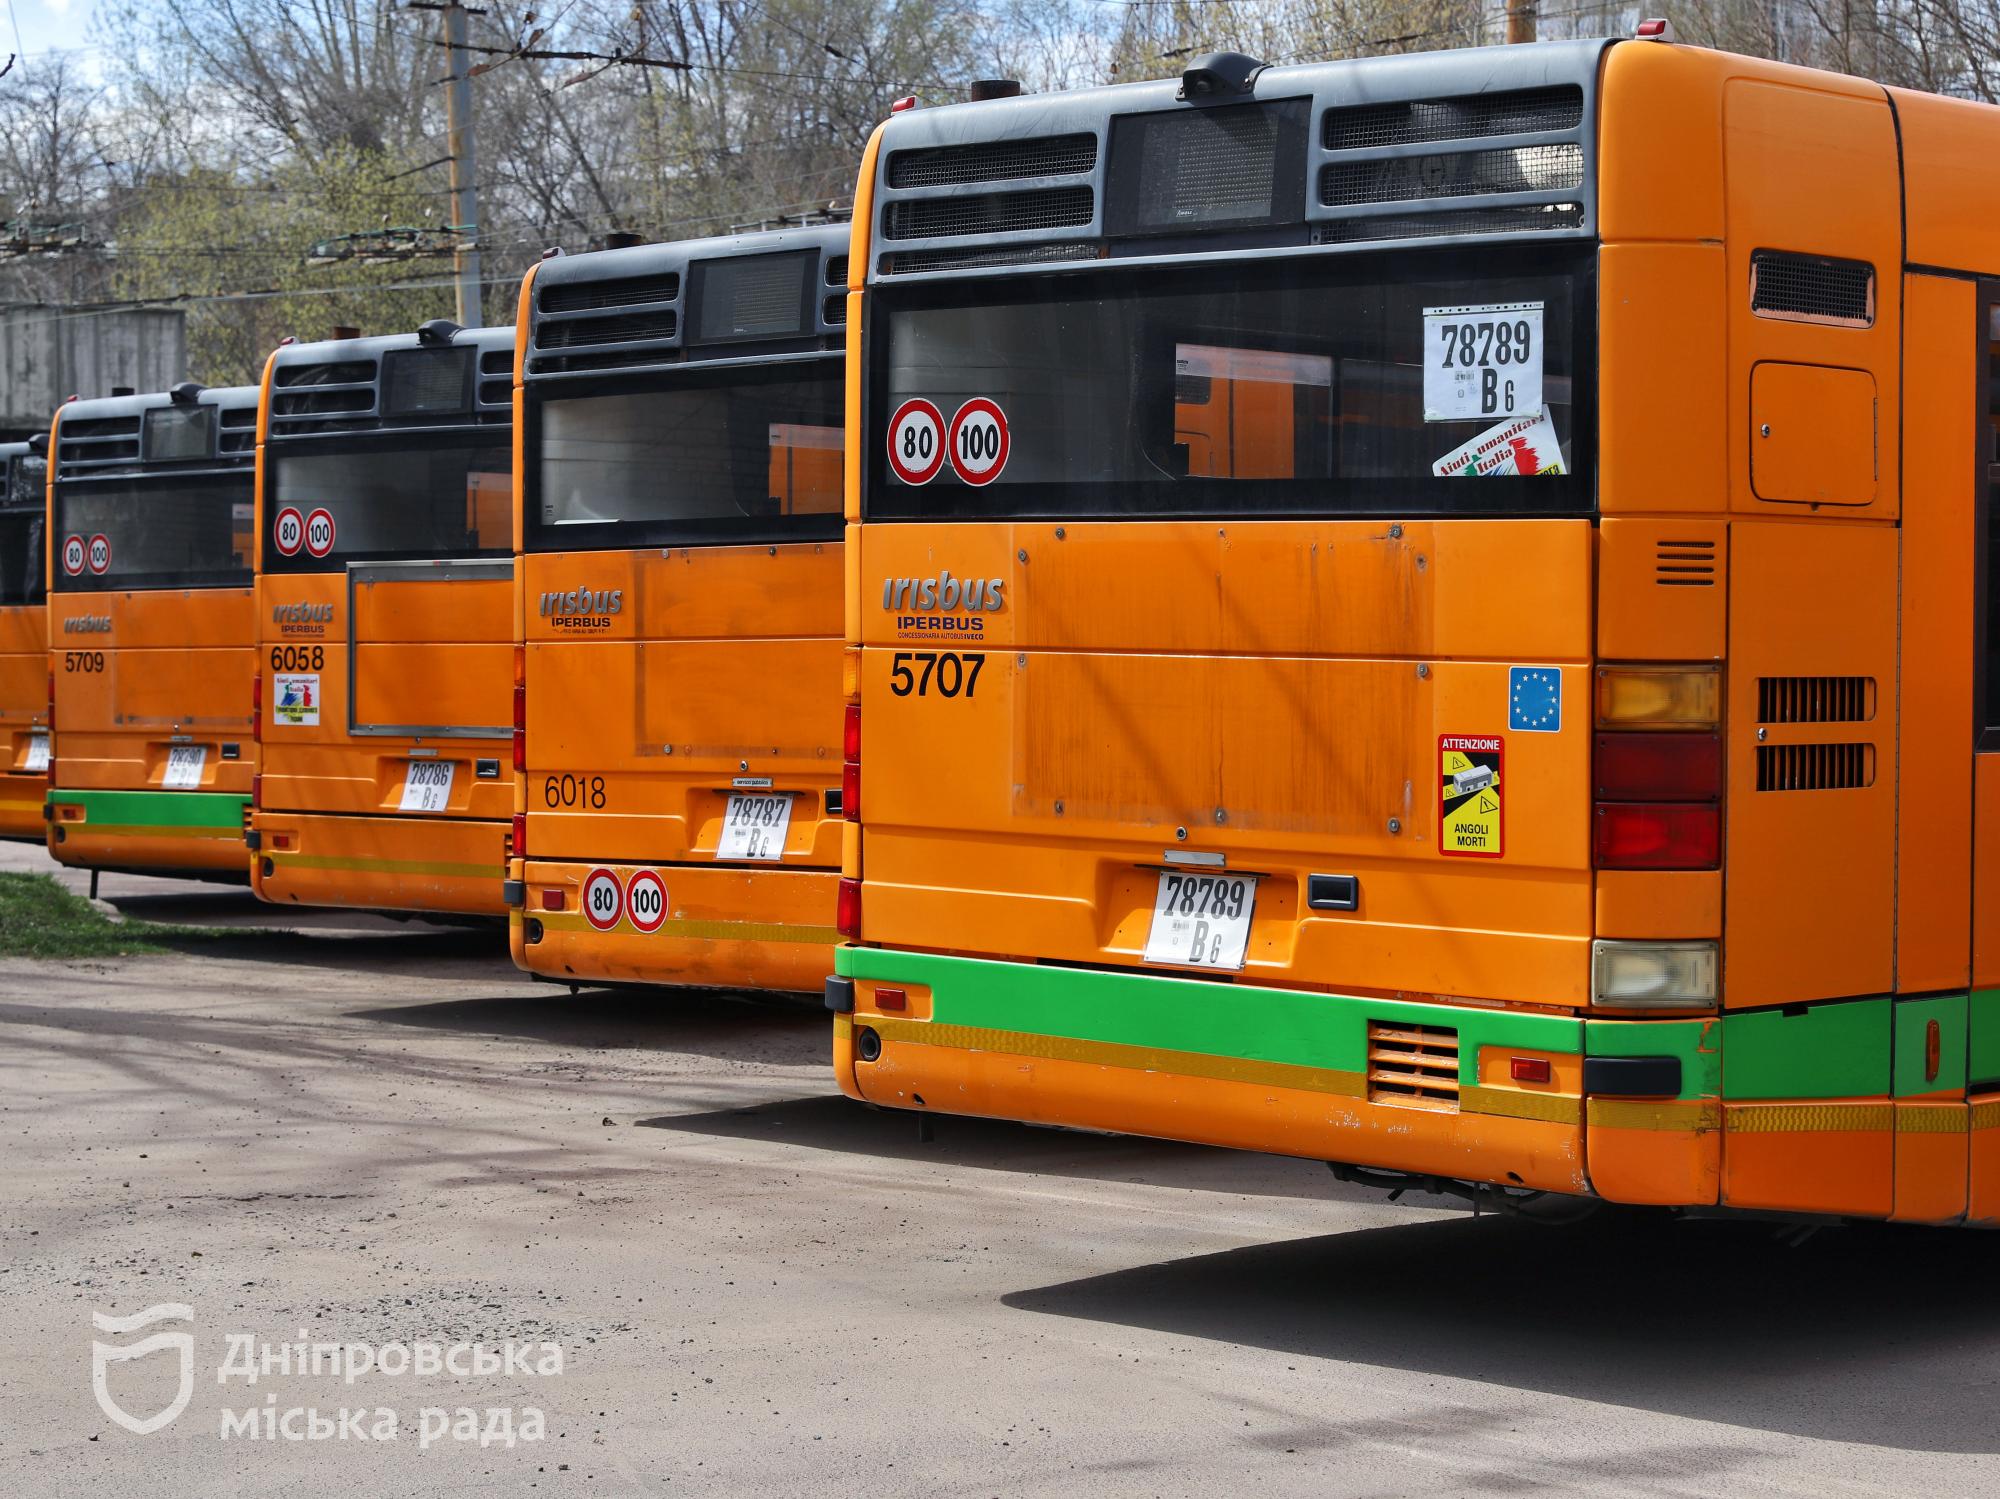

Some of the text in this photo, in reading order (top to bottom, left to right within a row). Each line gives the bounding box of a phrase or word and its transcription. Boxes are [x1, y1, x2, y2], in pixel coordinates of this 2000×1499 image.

[1442, 321, 1530, 368] 78789
[1482, 368, 1514, 413] B 6
[904, 426, 932, 458] 80
[961, 424, 999, 459] 100
[1477, 447, 1513, 473] Italia
[282, 523, 297, 540] 80
[311, 524, 329, 543] 100
[69, 548, 80, 562] 80
[92, 547, 107, 562] 100
[281, 625, 325, 633] IPERBUS
[552, 618, 611, 627] IPERBUS
[897, 616, 984, 631] IPERBUS
[65, 651, 104, 673] 5709
[271, 645, 324, 672] 6058
[890, 652, 985, 698] 5707
[1442, 738, 1500, 750] ATTENZIONE
[410, 764, 450, 786] 78786
[544, 774, 606, 809] 6018
[730, 798, 787, 827] 78787
[1454, 823, 1489, 835] ANGOLI
[1457, 836, 1486, 847] MORTI
[747, 828, 761, 857] B
[593, 887, 614, 912] 80
[633, 889, 661, 914] 100
[1163, 876, 1246, 921] 78789
[1188, 920, 1209, 962] B
